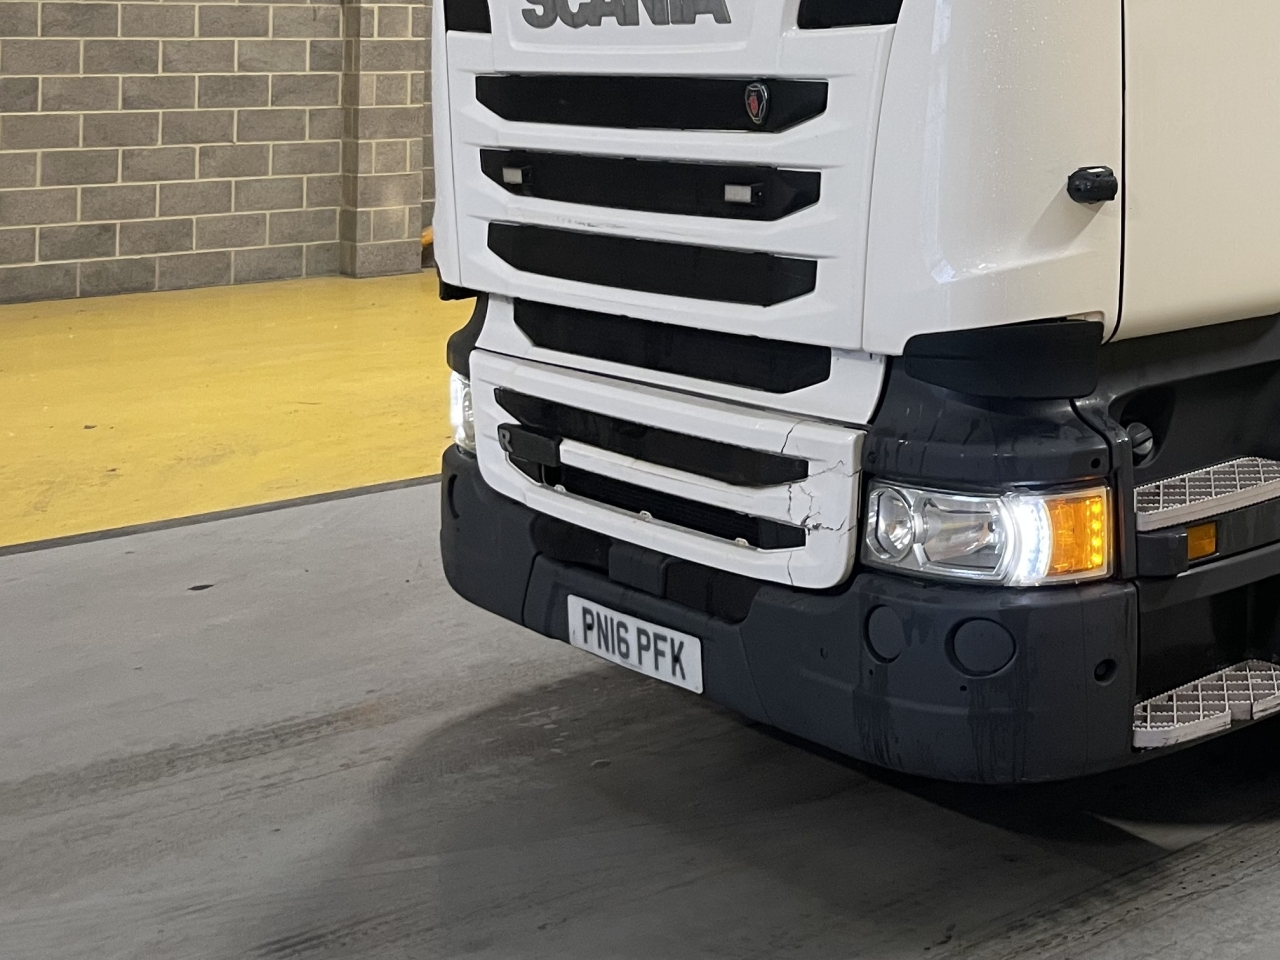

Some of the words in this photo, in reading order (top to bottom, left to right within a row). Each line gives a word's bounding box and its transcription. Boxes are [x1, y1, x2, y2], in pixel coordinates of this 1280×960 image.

[498, 428, 514, 453] R
[581, 606, 631, 661] PN16
[636, 626, 687, 681] PFK
